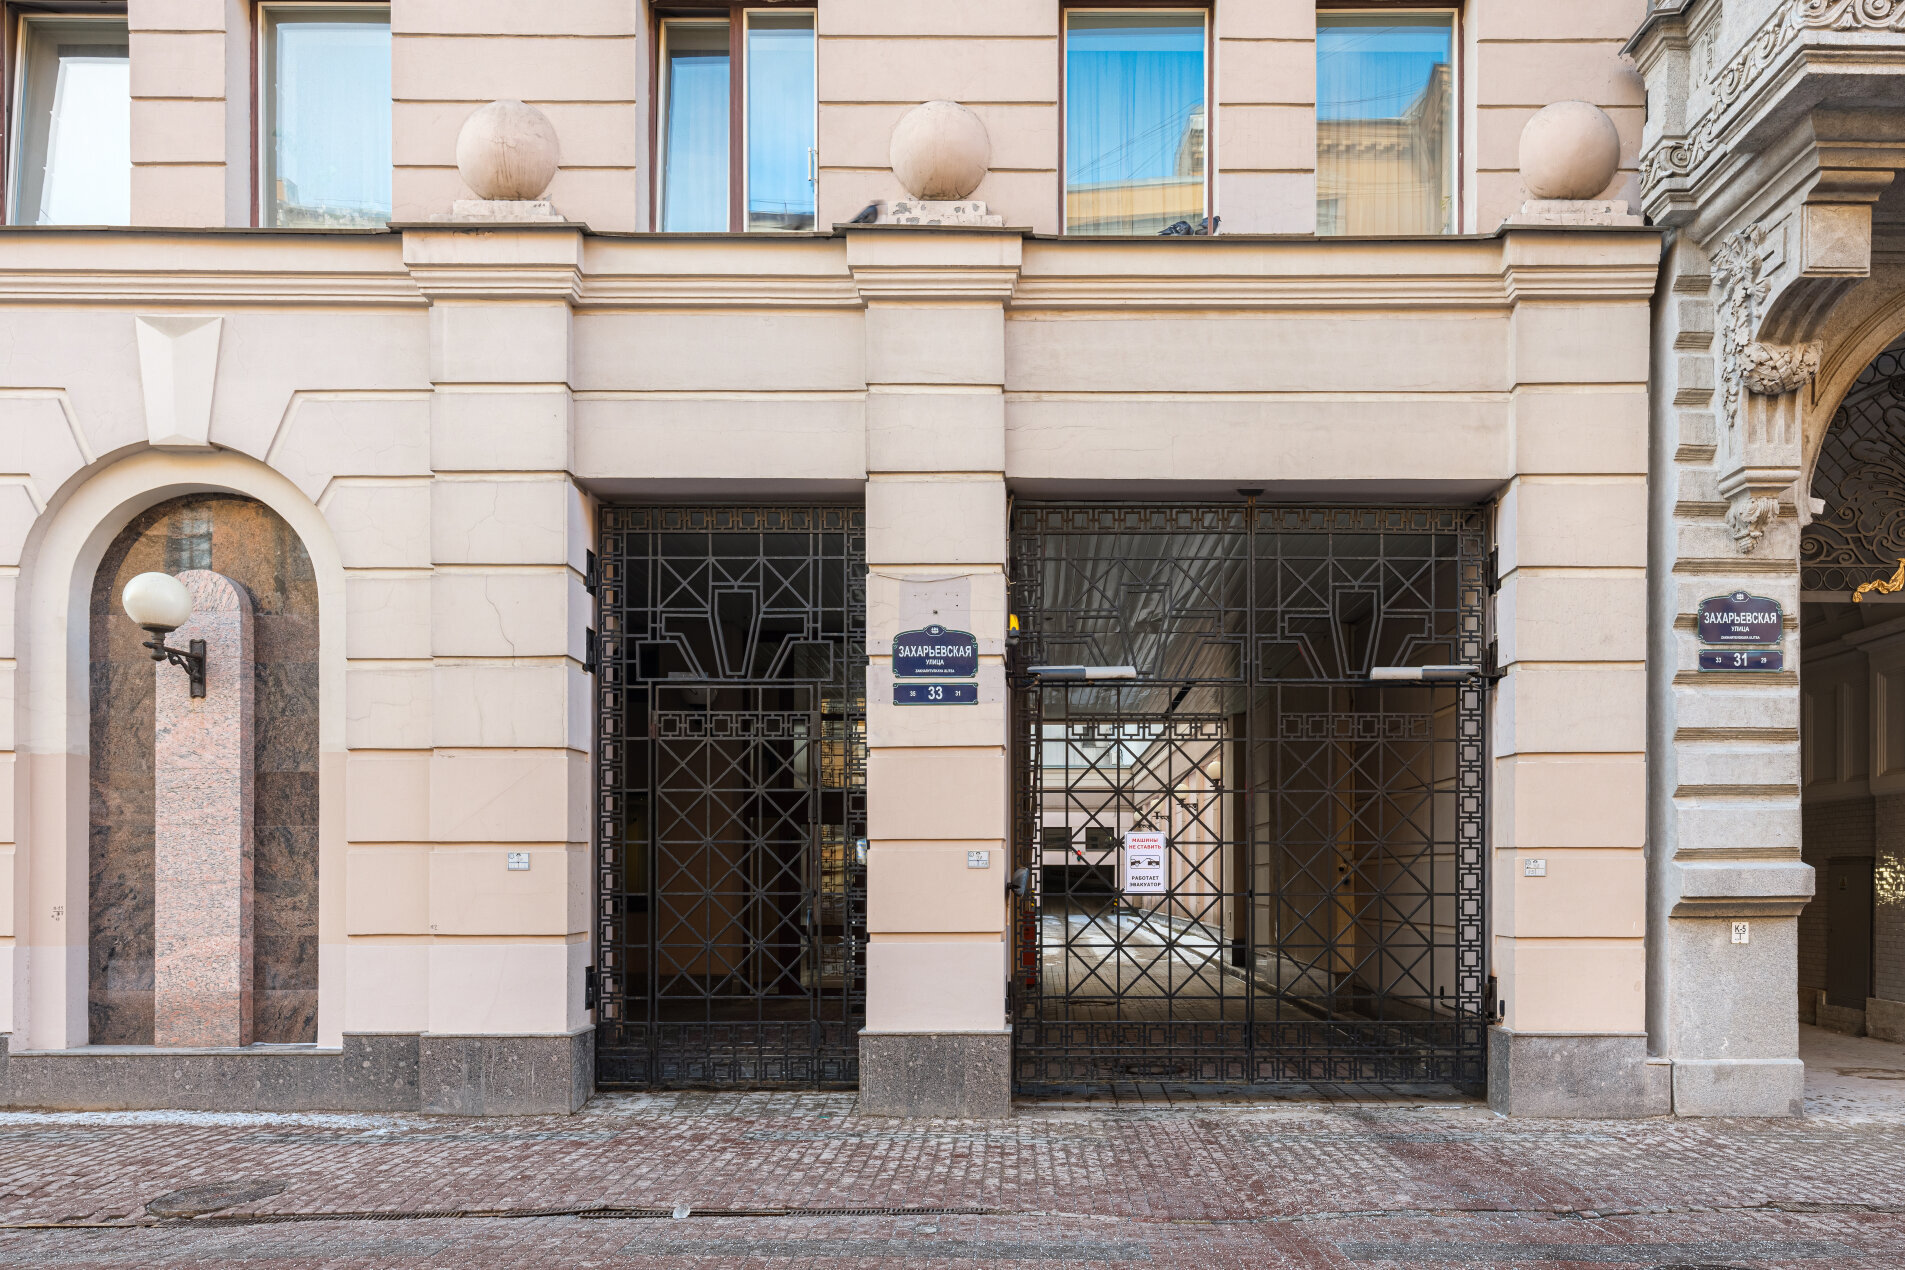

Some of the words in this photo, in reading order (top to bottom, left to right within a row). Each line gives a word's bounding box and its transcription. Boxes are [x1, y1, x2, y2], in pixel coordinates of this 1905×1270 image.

[1704, 612, 1777, 624] ЗАХАРЬЕВСКАЯ
[898, 645, 972, 657] ЗАХАРЬЕВСКАЯ
[1733, 652, 1748, 667] 31
[927, 686, 943, 700] 33
